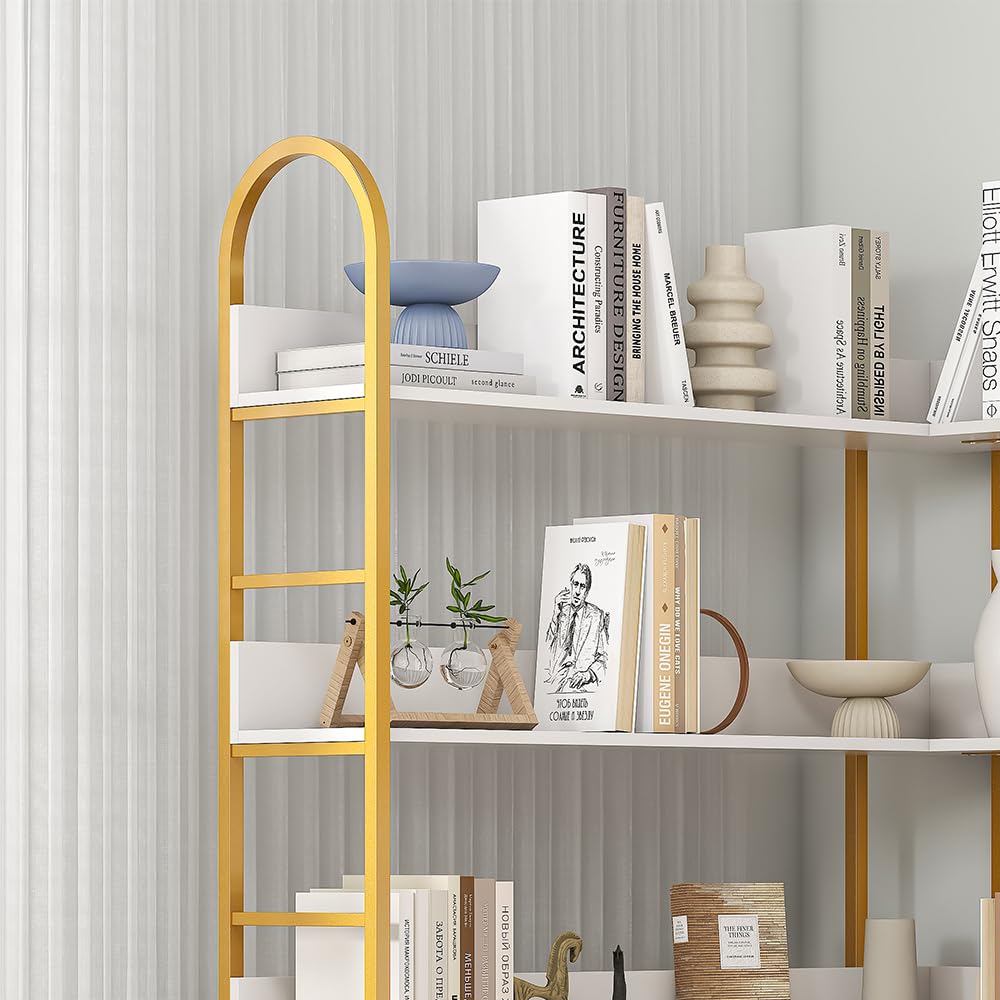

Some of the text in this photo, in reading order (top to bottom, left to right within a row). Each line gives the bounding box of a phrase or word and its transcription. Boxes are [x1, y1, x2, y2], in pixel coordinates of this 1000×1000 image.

[572, 212, 586, 375] ARCHITECTURE
[592, 245, 603, 298] Constructing
[613, 192, 624, 401] FURNITURE DESIGN
[632, 243, 642, 359] BRINGING THE HOUSE HOME
[663, 272, 681, 346] MARCEL BREUER
[401, 373, 458, 386] JODI PICOULT
[425, 351, 470, 367] SCHIELE
[471, 379, 516, 389] second glance
[675, 607, 681, 618] DO
[675, 620, 681, 632] WE
[659, 623, 671, 725] EUGENE ONEGIN
[502, 905, 510, 951] НОВЫЙ
